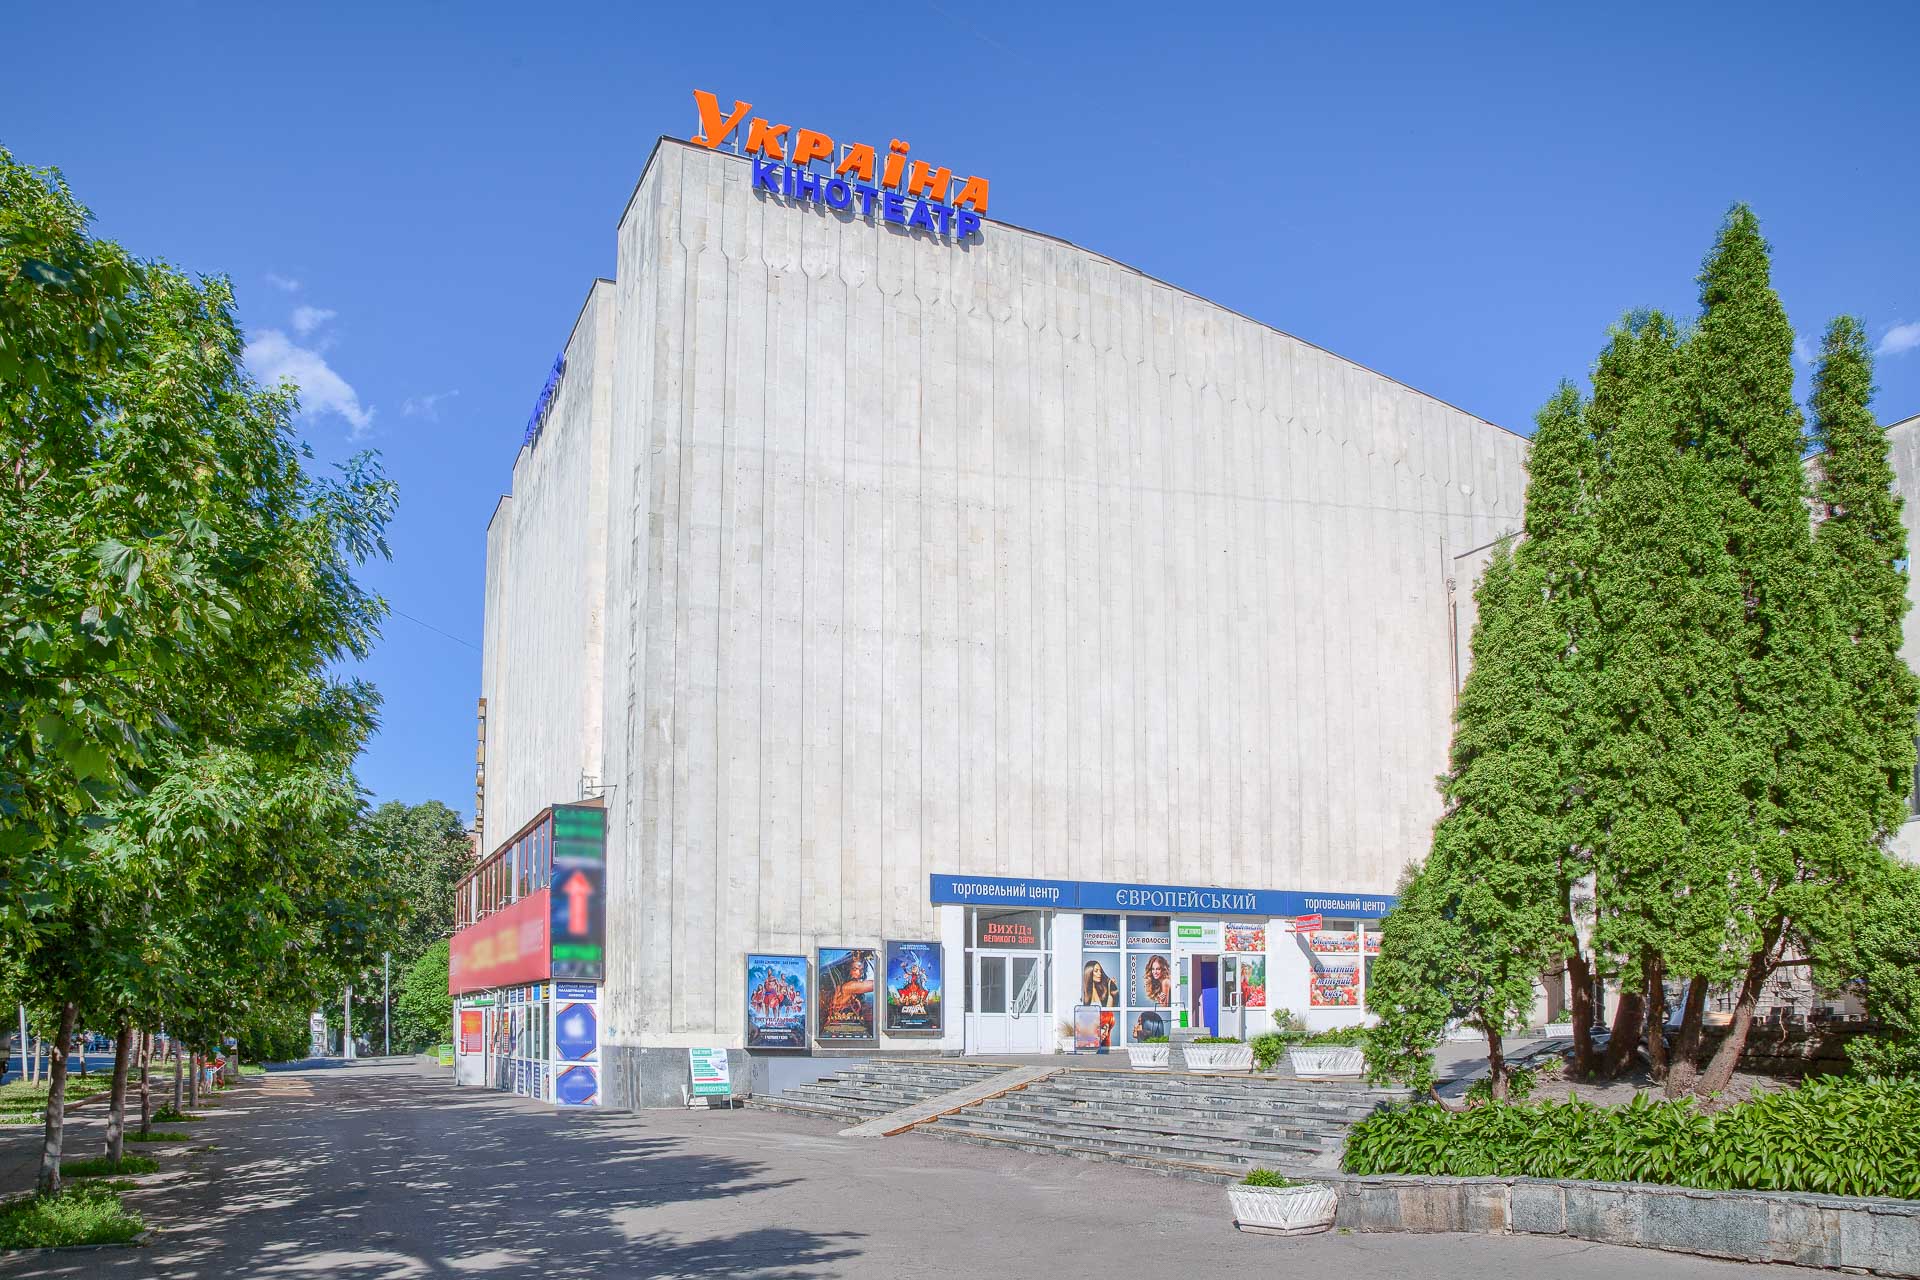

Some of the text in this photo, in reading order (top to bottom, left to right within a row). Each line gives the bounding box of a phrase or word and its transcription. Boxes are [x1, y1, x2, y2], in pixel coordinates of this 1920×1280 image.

[690, 89, 990, 214] УКРАЇНА
[752, 158, 982, 239] КІНОТЕАТР
[951, 882, 1060, 903] торговельний центр
[1115, 889, 1257, 910] ЄВРОПЕЙСЬКИЙ
[1304, 898, 1386, 915] торговельний центр
[1127, 937, 1140, 945] ДЛЯ
